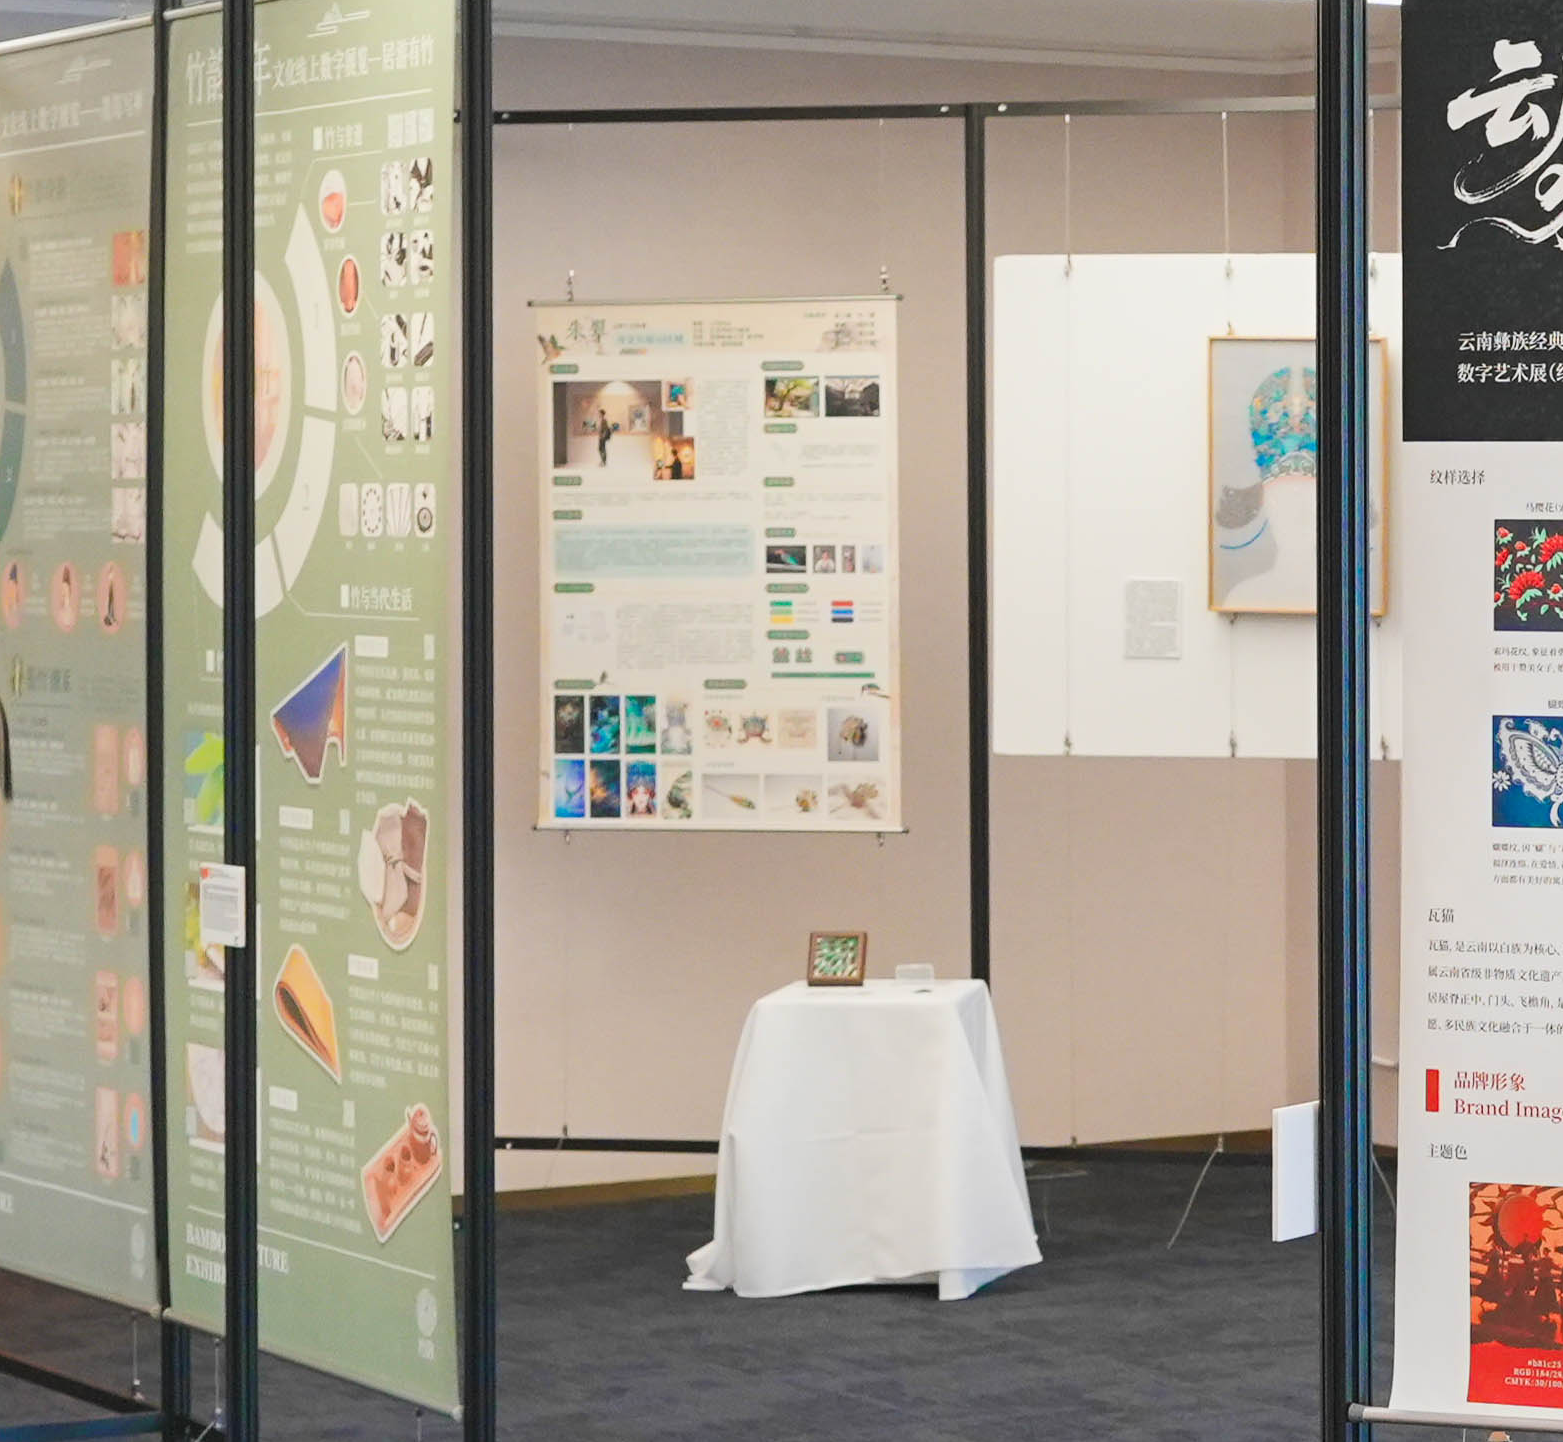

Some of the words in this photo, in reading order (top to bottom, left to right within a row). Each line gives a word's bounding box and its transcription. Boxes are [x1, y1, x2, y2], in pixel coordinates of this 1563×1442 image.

[1429, 469, 1485, 486] 纹样选择
[1427, 908, 1454, 923] 瓦猫
[1454, 1071, 1526, 1093] 品牌形象
[1454, 1098, 1509, 1118] Brand
[1426, 1142, 1468, 1160] 主题色
